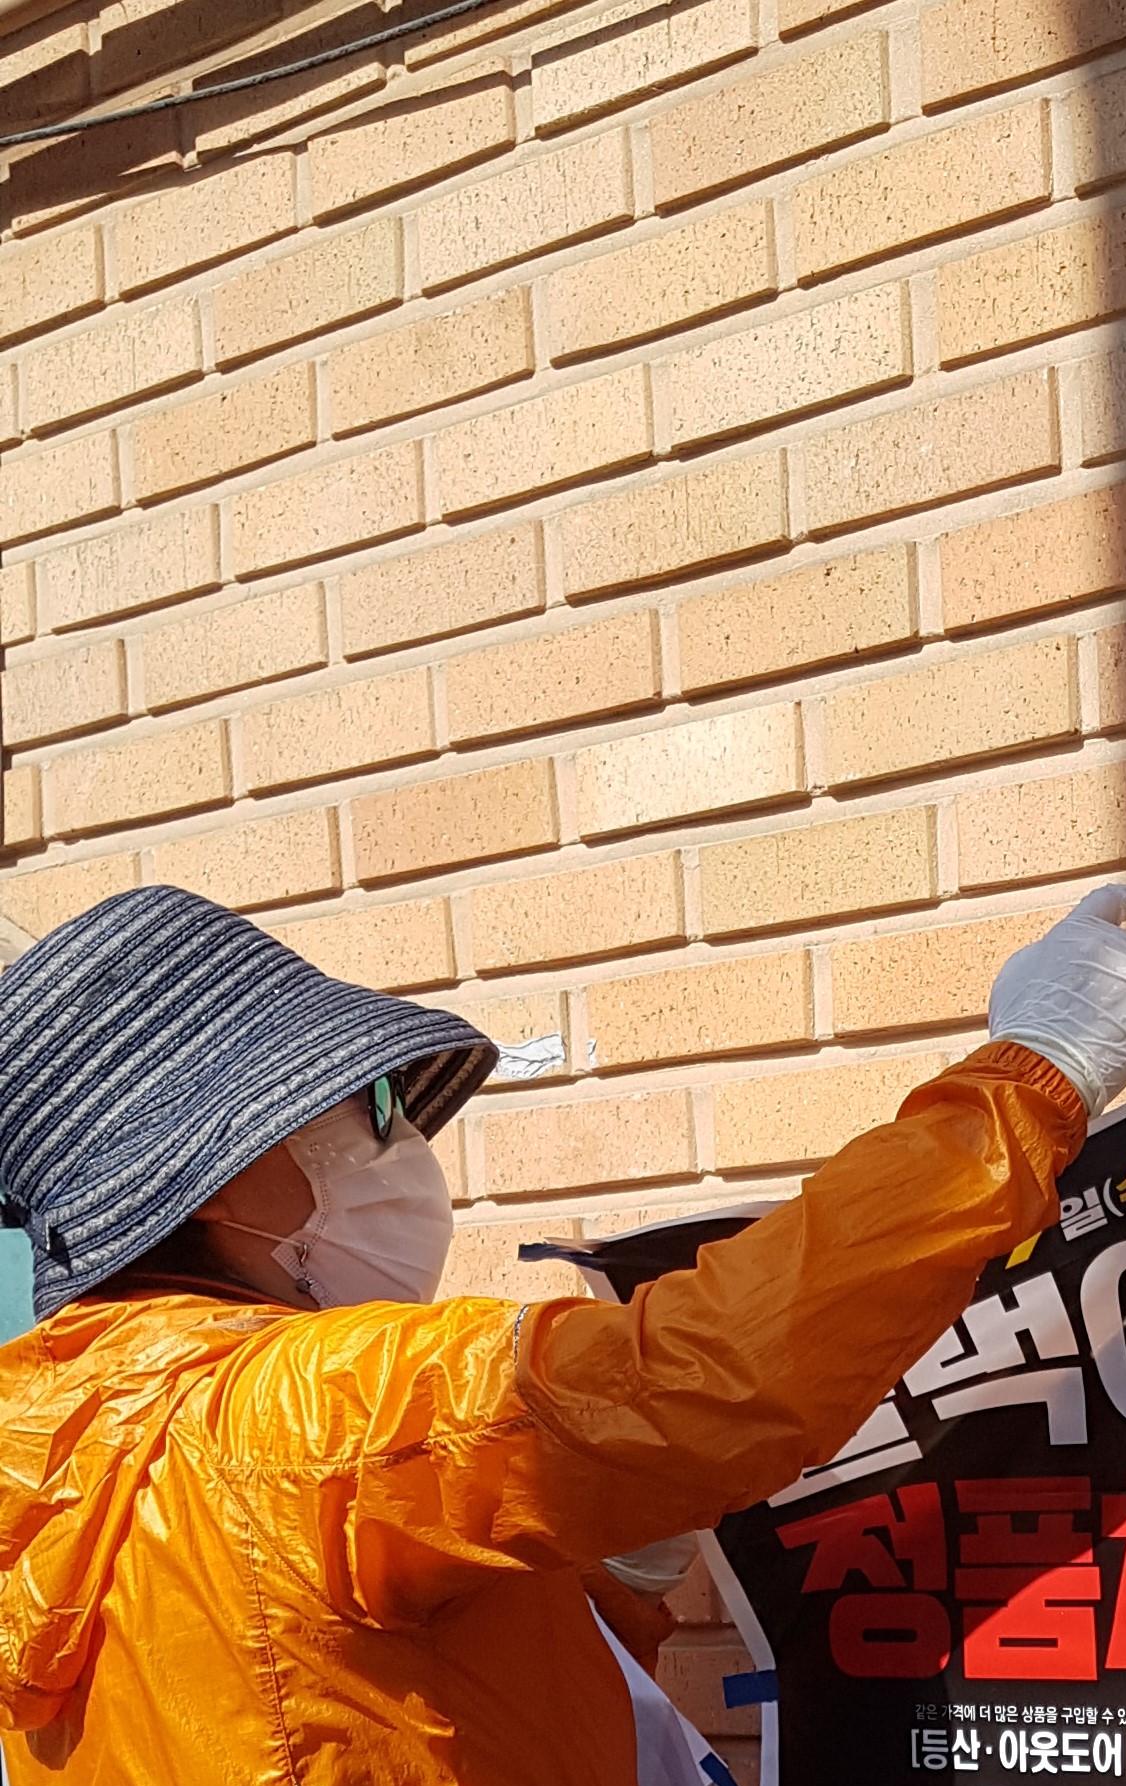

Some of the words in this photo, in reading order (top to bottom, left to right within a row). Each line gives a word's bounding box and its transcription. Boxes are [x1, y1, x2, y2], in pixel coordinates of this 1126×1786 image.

[915, 1704, 938, 1720] 같은
[941, 1704, 976, 1722] 가격에
[979, 1705, 991, 1722] 더
[994, 1706, 1019, 1723] 많은
[1021, 1705, 1058, 1724] 상품을
[1061, 1707, 1098, 1726] 구입할
[1101, 1707, 1115, 1726] 수
